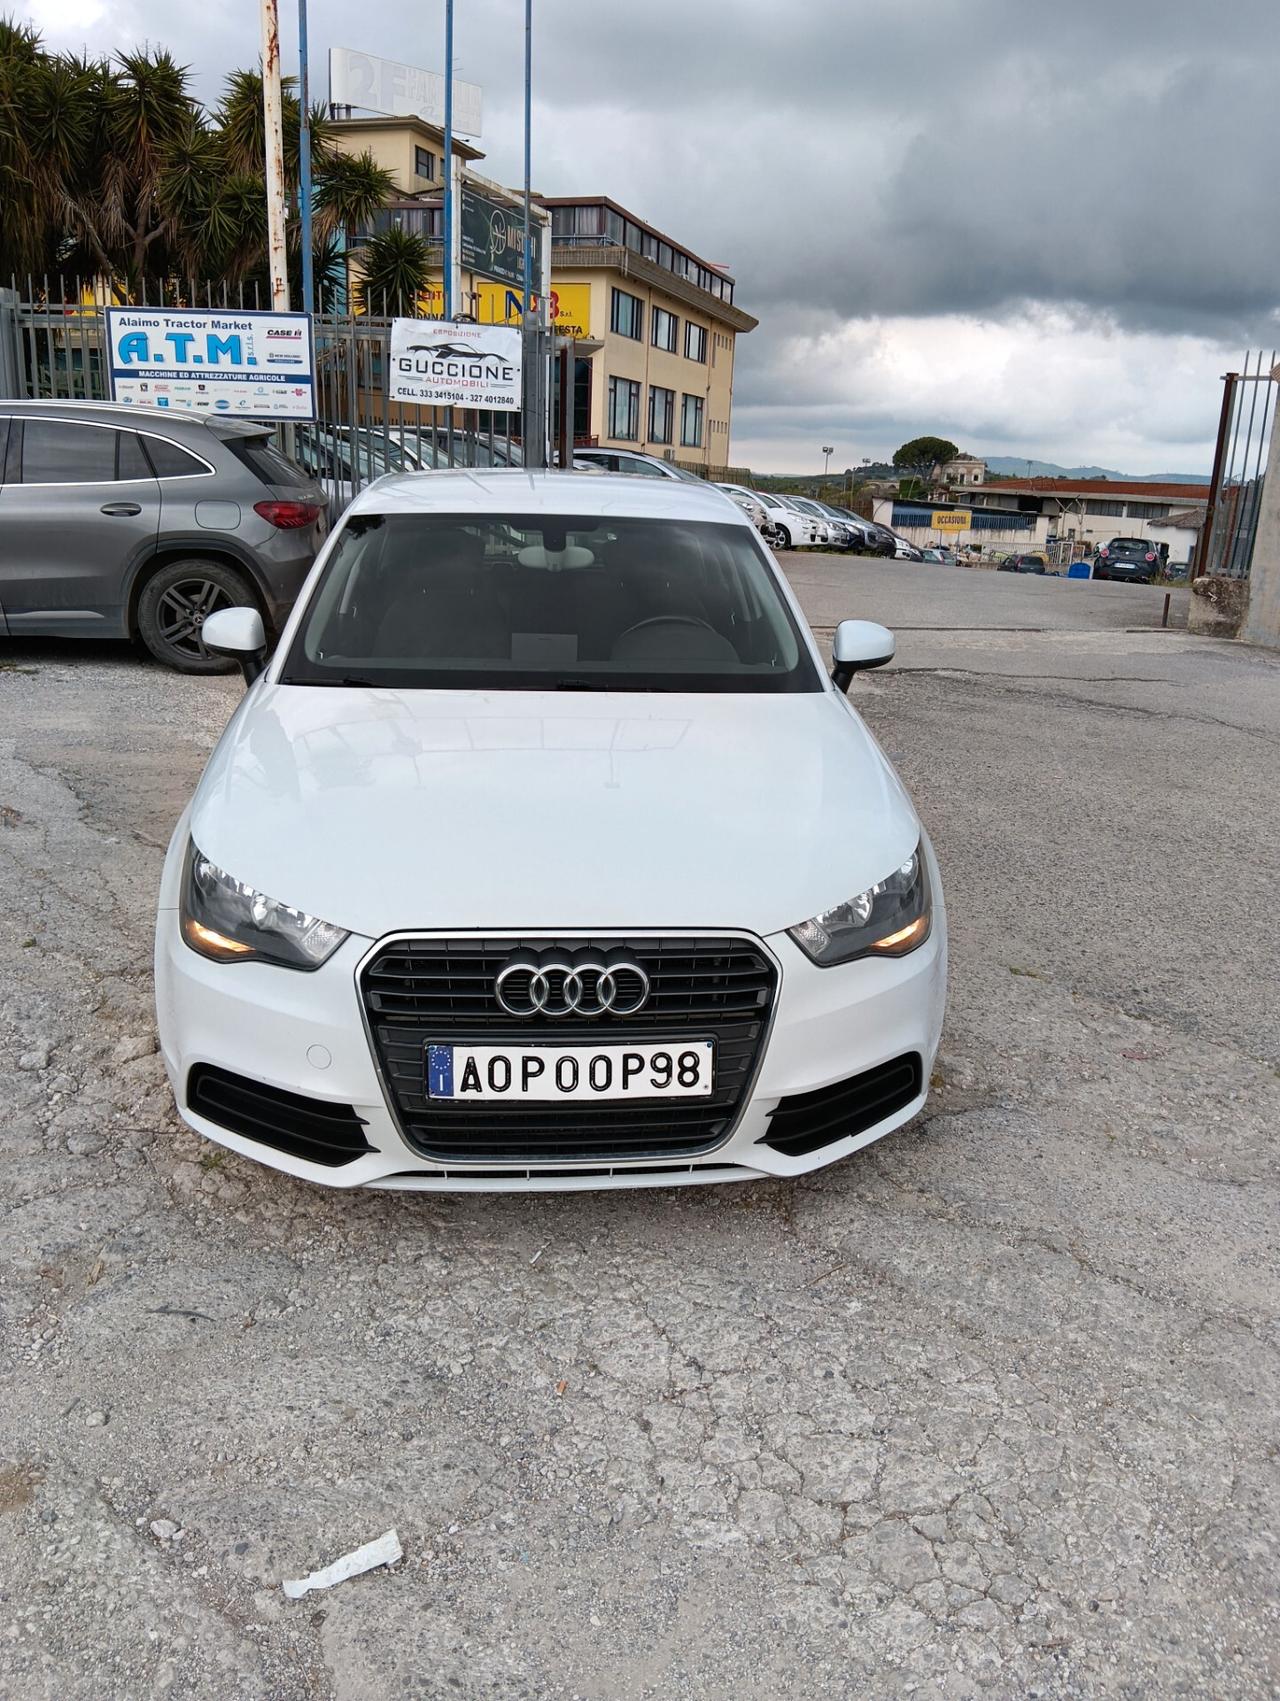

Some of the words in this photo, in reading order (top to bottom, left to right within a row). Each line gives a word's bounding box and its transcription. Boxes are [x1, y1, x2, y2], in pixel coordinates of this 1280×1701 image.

[119, 317, 160, 328] Alaimo
[163, 318, 208, 330] Tractor
[211, 320, 253, 331] Market
[432, 328, 482, 338] ESPOSIZIONE
[118, 331, 258, 366] A.T.M.
[138, 370, 178, 378] MACCHINE
[179, 371, 190, 379] ED
[191, 372, 247, 381] ATTREZZATURE
[248, 374, 286, 382] AGRICOLE
[399, 358, 514, 381] GUCCIONE
[425, 376, 489, 388] AUTOMOBILI
[397, 387, 418, 397] CELL.
[419, 389, 433, 398] 333
[434, 391, 464, 401] 3415104
[470, 393, 483, 402] 327
[484, 395, 515, 405] 4012840
